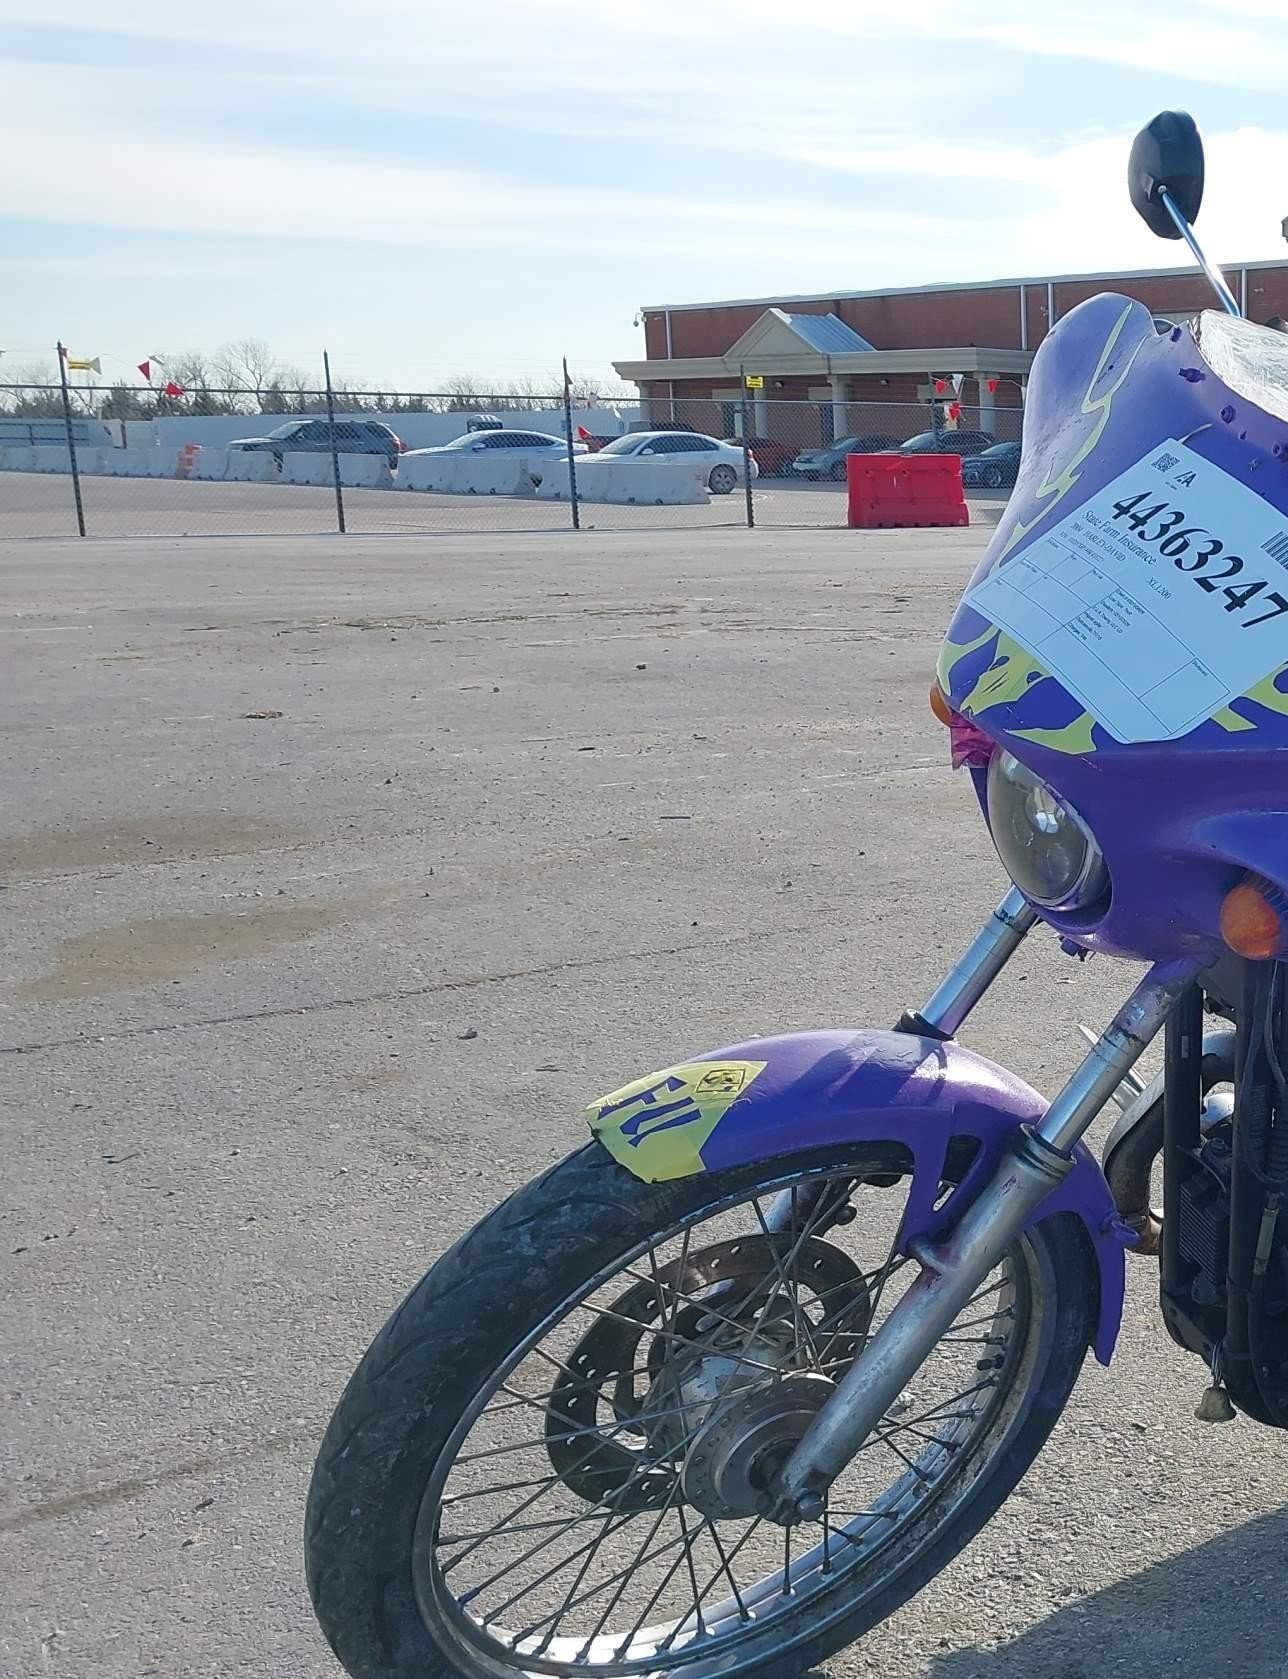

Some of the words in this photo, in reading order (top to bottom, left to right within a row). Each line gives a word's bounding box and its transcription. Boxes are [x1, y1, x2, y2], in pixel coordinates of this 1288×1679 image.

[1082, 509, 1101, 527] State
[1100, 520, 1121, 541] Farm
[1118, 533, 1157, 566] Insurance
